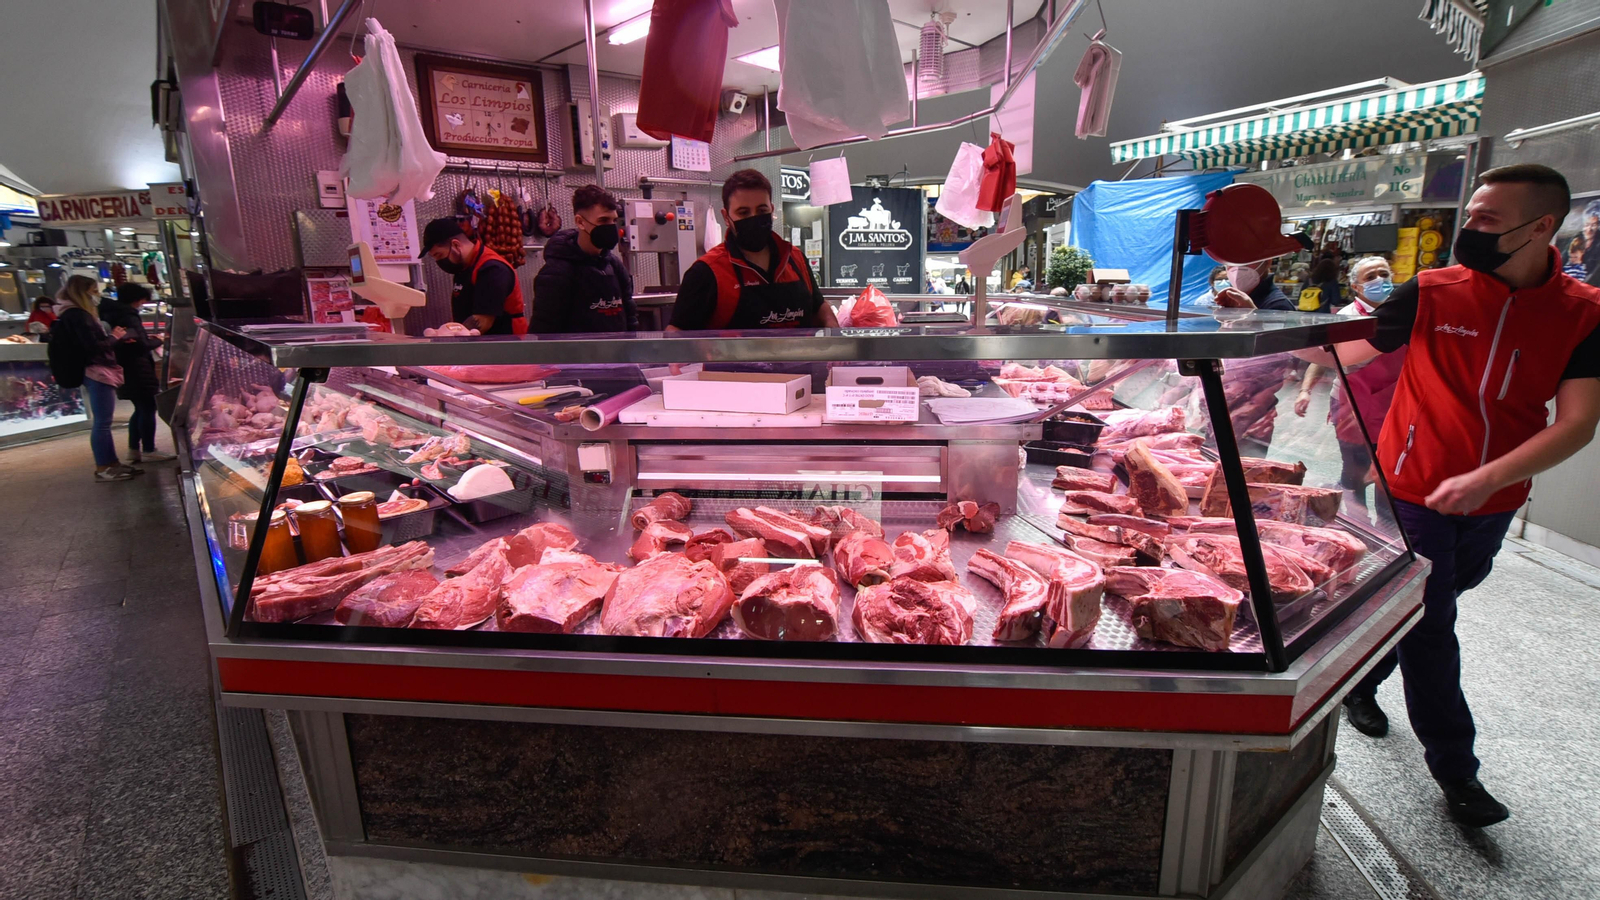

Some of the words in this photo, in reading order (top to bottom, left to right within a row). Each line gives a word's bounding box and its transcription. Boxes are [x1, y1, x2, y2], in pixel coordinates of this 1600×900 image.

[439, 93, 467, 105] Los
[471, 96, 532, 113] Limpios
[502, 136, 533, 147] Propia
[780, 175, 803, 189] TOS
[1389, 181, 1411, 192] 116
[167, 186, 185, 195] ES
[1329, 190, 1365, 199] Sandra
[37, 196, 143, 222] CARNICERIA
[155, 206, 189, 216] DER
[849, 232, 867, 244] J.M.
[868, 232, 905, 243] SANTOS
